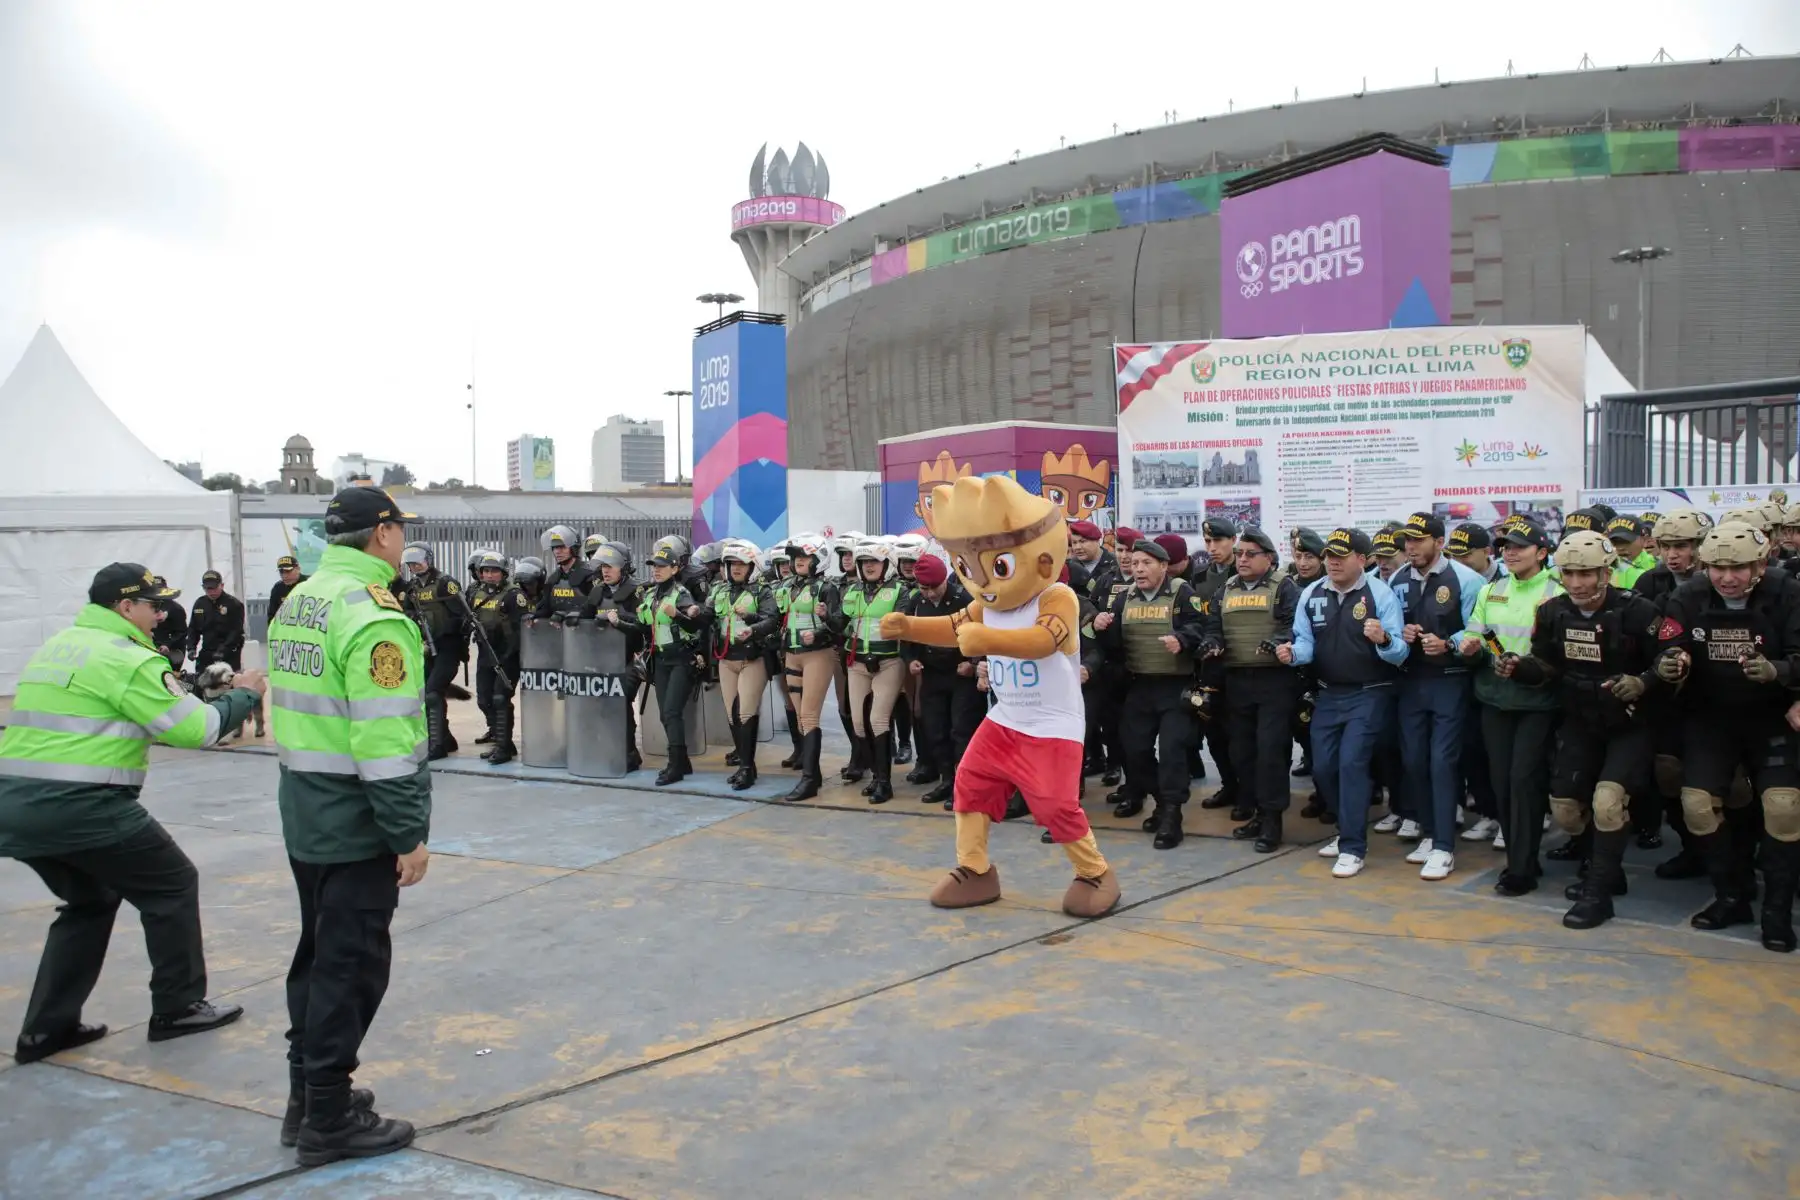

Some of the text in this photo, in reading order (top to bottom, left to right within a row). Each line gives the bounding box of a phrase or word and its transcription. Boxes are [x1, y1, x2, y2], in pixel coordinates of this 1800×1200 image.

[1271, 214, 1361, 263] PANAM
[1269, 245, 1364, 294] SPORTS
[1301, 347, 1400, 363] NACIONAL
[1407, 345, 1443, 358] DEL
[1450, 344, 1500, 356] PERU
[1329, 363, 1420, 377] POLICIAL
[1427, 361, 1475, 373] LIMA
[700, 380, 729, 410] 2019
[1184, 391, 1205, 403] PLAN
[1207, 390, 1219, 402] DE
[1220, 387, 1280, 401] OPERACIONES
[1282, 385, 1331, 399] POLICIALES
[1374, 381, 1410, 395] PATRIAS
[1412, 380, 1418, 393] Y
[1420, 380, 1452, 393] JUEGOS
[1454, 378, 1527, 391] PANAMERICANOS
[1169, 441, 1177, 450] DE
[1178, 441, 1190, 450] LAS
[1190, 439, 1231, 450] ACTIVIDADES
[1232, 438, 1263, 448] OFICIALES
[1484, 452, 1514, 462] 2019
[1434, 484, 1561, 496] UNIDADES PARTICIPANTES
[1589, 494, 1659, 505] INAUGURACIÓN
[1309, 597, 1327, 622] T
